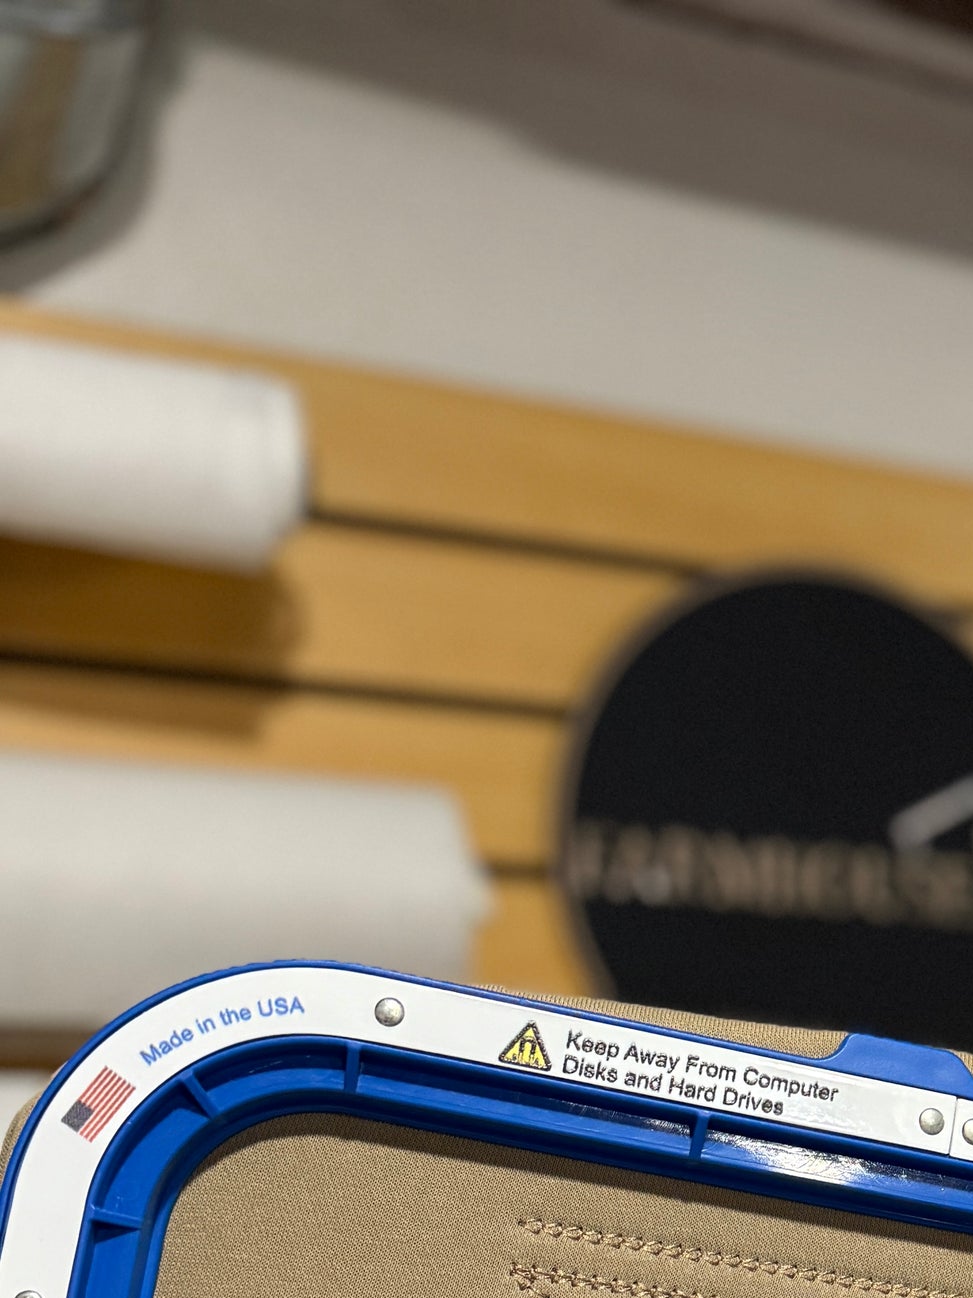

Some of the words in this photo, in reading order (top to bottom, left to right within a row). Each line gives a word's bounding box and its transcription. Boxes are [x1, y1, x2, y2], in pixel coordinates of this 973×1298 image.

[139, 1029, 195, 1067] Made
[195, 1017, 217, 1034] in
[219, 1007, 252, 1028] the
[257, 996, 306, 1017] USA
[565, 1028, 620, 1060] Keep
[624, 1043, 681, 1074] Away
[685, 1054, 737, 1083] From
[742, 1065, 840, 1102] Computer
[562, 1054, 618, 1085] Disks
[624, 1070, 663, 1093] and
[668, 1079, 717, 1104] Hard
[721, 1088, 785, 1116] Drives
